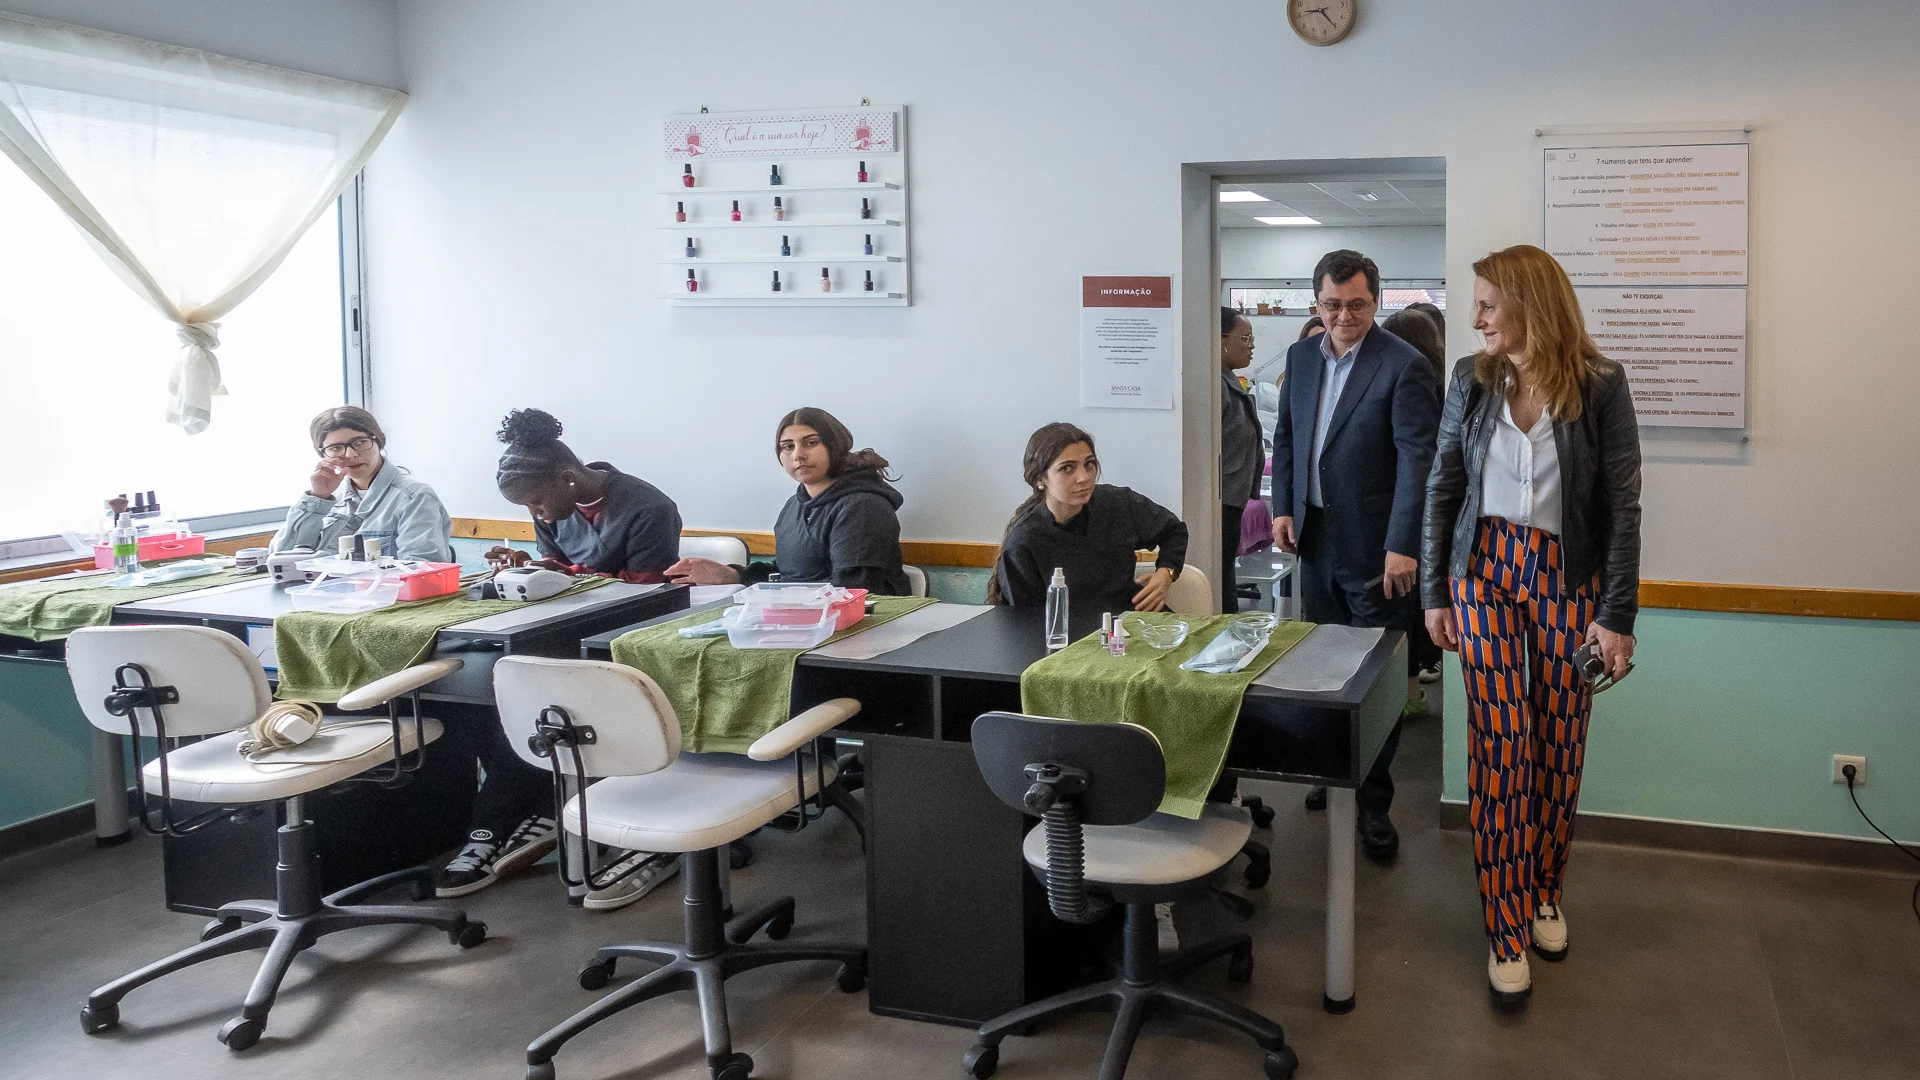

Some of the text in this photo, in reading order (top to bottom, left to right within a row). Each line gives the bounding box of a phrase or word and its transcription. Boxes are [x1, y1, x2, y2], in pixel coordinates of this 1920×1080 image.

[724, 125, 751, 144] Qual
[752, 131, 757, 140] é
[759, 133, 765, 141] a
[784, 132, 798, 140] cor
[799, 124, 827, 147] hoje?
[1601, 157, 1627, 165] números
[1627, 158, 1639, 167] que
[1639, 157, 1652, 165] tens
[1653, 157, 1664, 165] que
[1665, 156, 1694, 165] aprender:
[1100, 288, 1152, 296] INFORMAÇÃO
